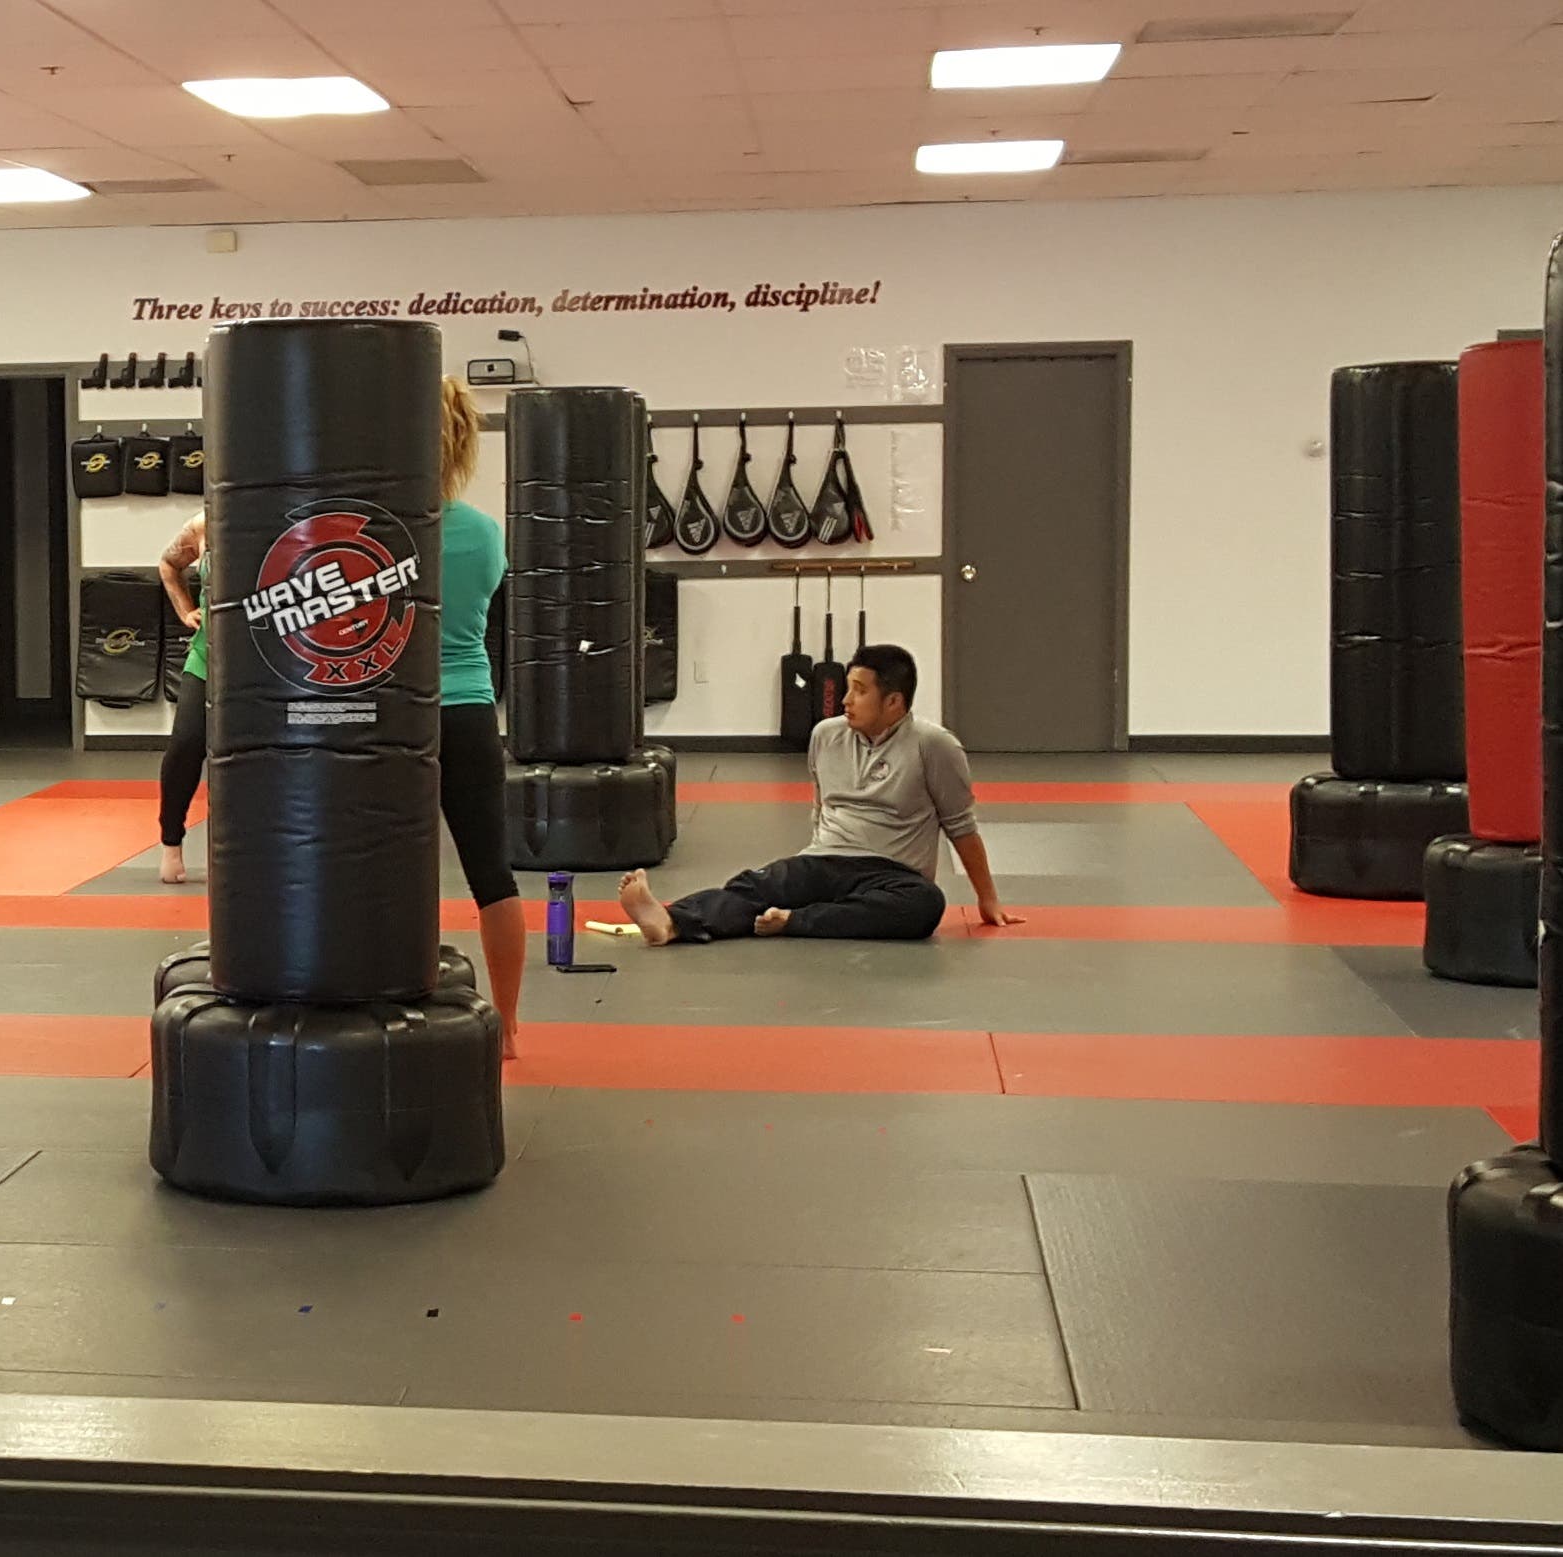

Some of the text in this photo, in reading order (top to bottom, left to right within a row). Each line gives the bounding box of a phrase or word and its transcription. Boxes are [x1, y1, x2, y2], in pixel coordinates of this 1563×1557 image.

[132, 280, 881, 320] Three keys to success: dedication, determination, discipline!
[242, 561, 347, 621] WAVE
[272, 556, 420, 637] MASTER
